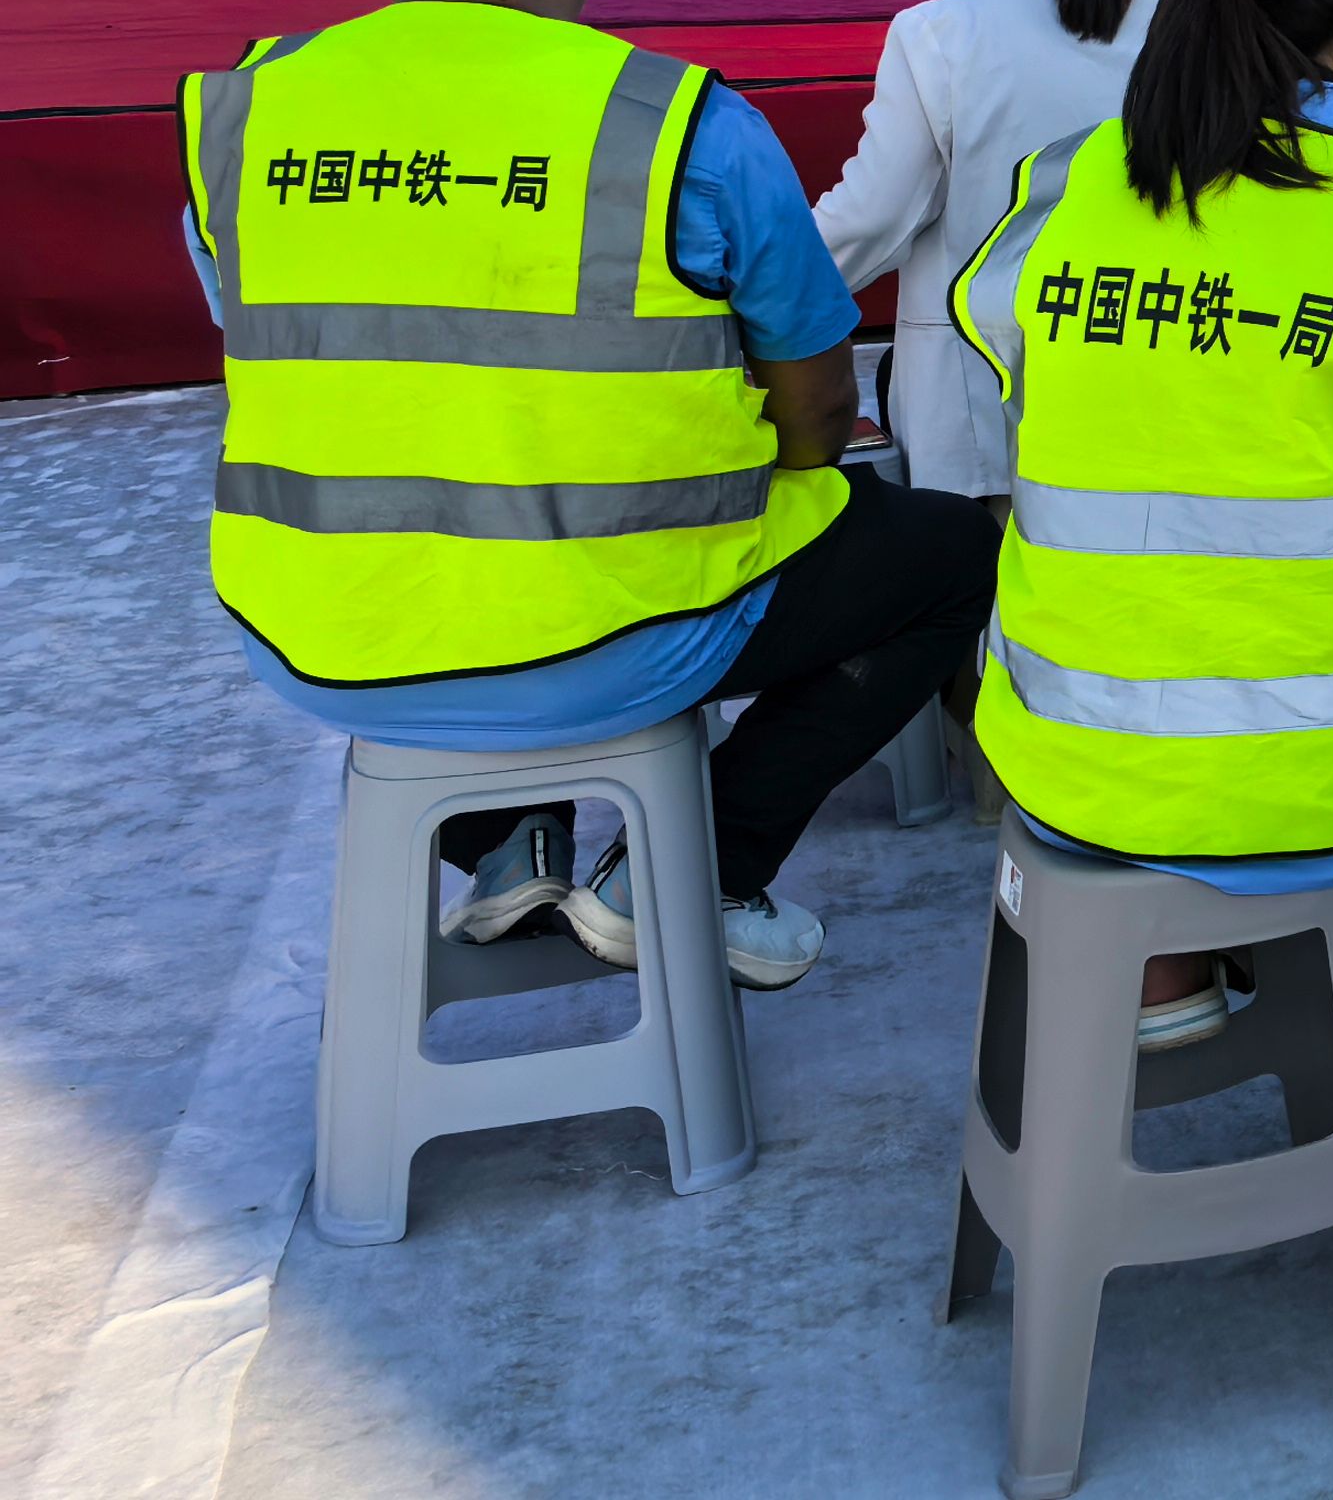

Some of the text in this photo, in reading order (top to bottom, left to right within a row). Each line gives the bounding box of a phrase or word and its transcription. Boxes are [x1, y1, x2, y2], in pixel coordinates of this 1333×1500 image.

[267, 148, 550, 212] 中国中铁一局
